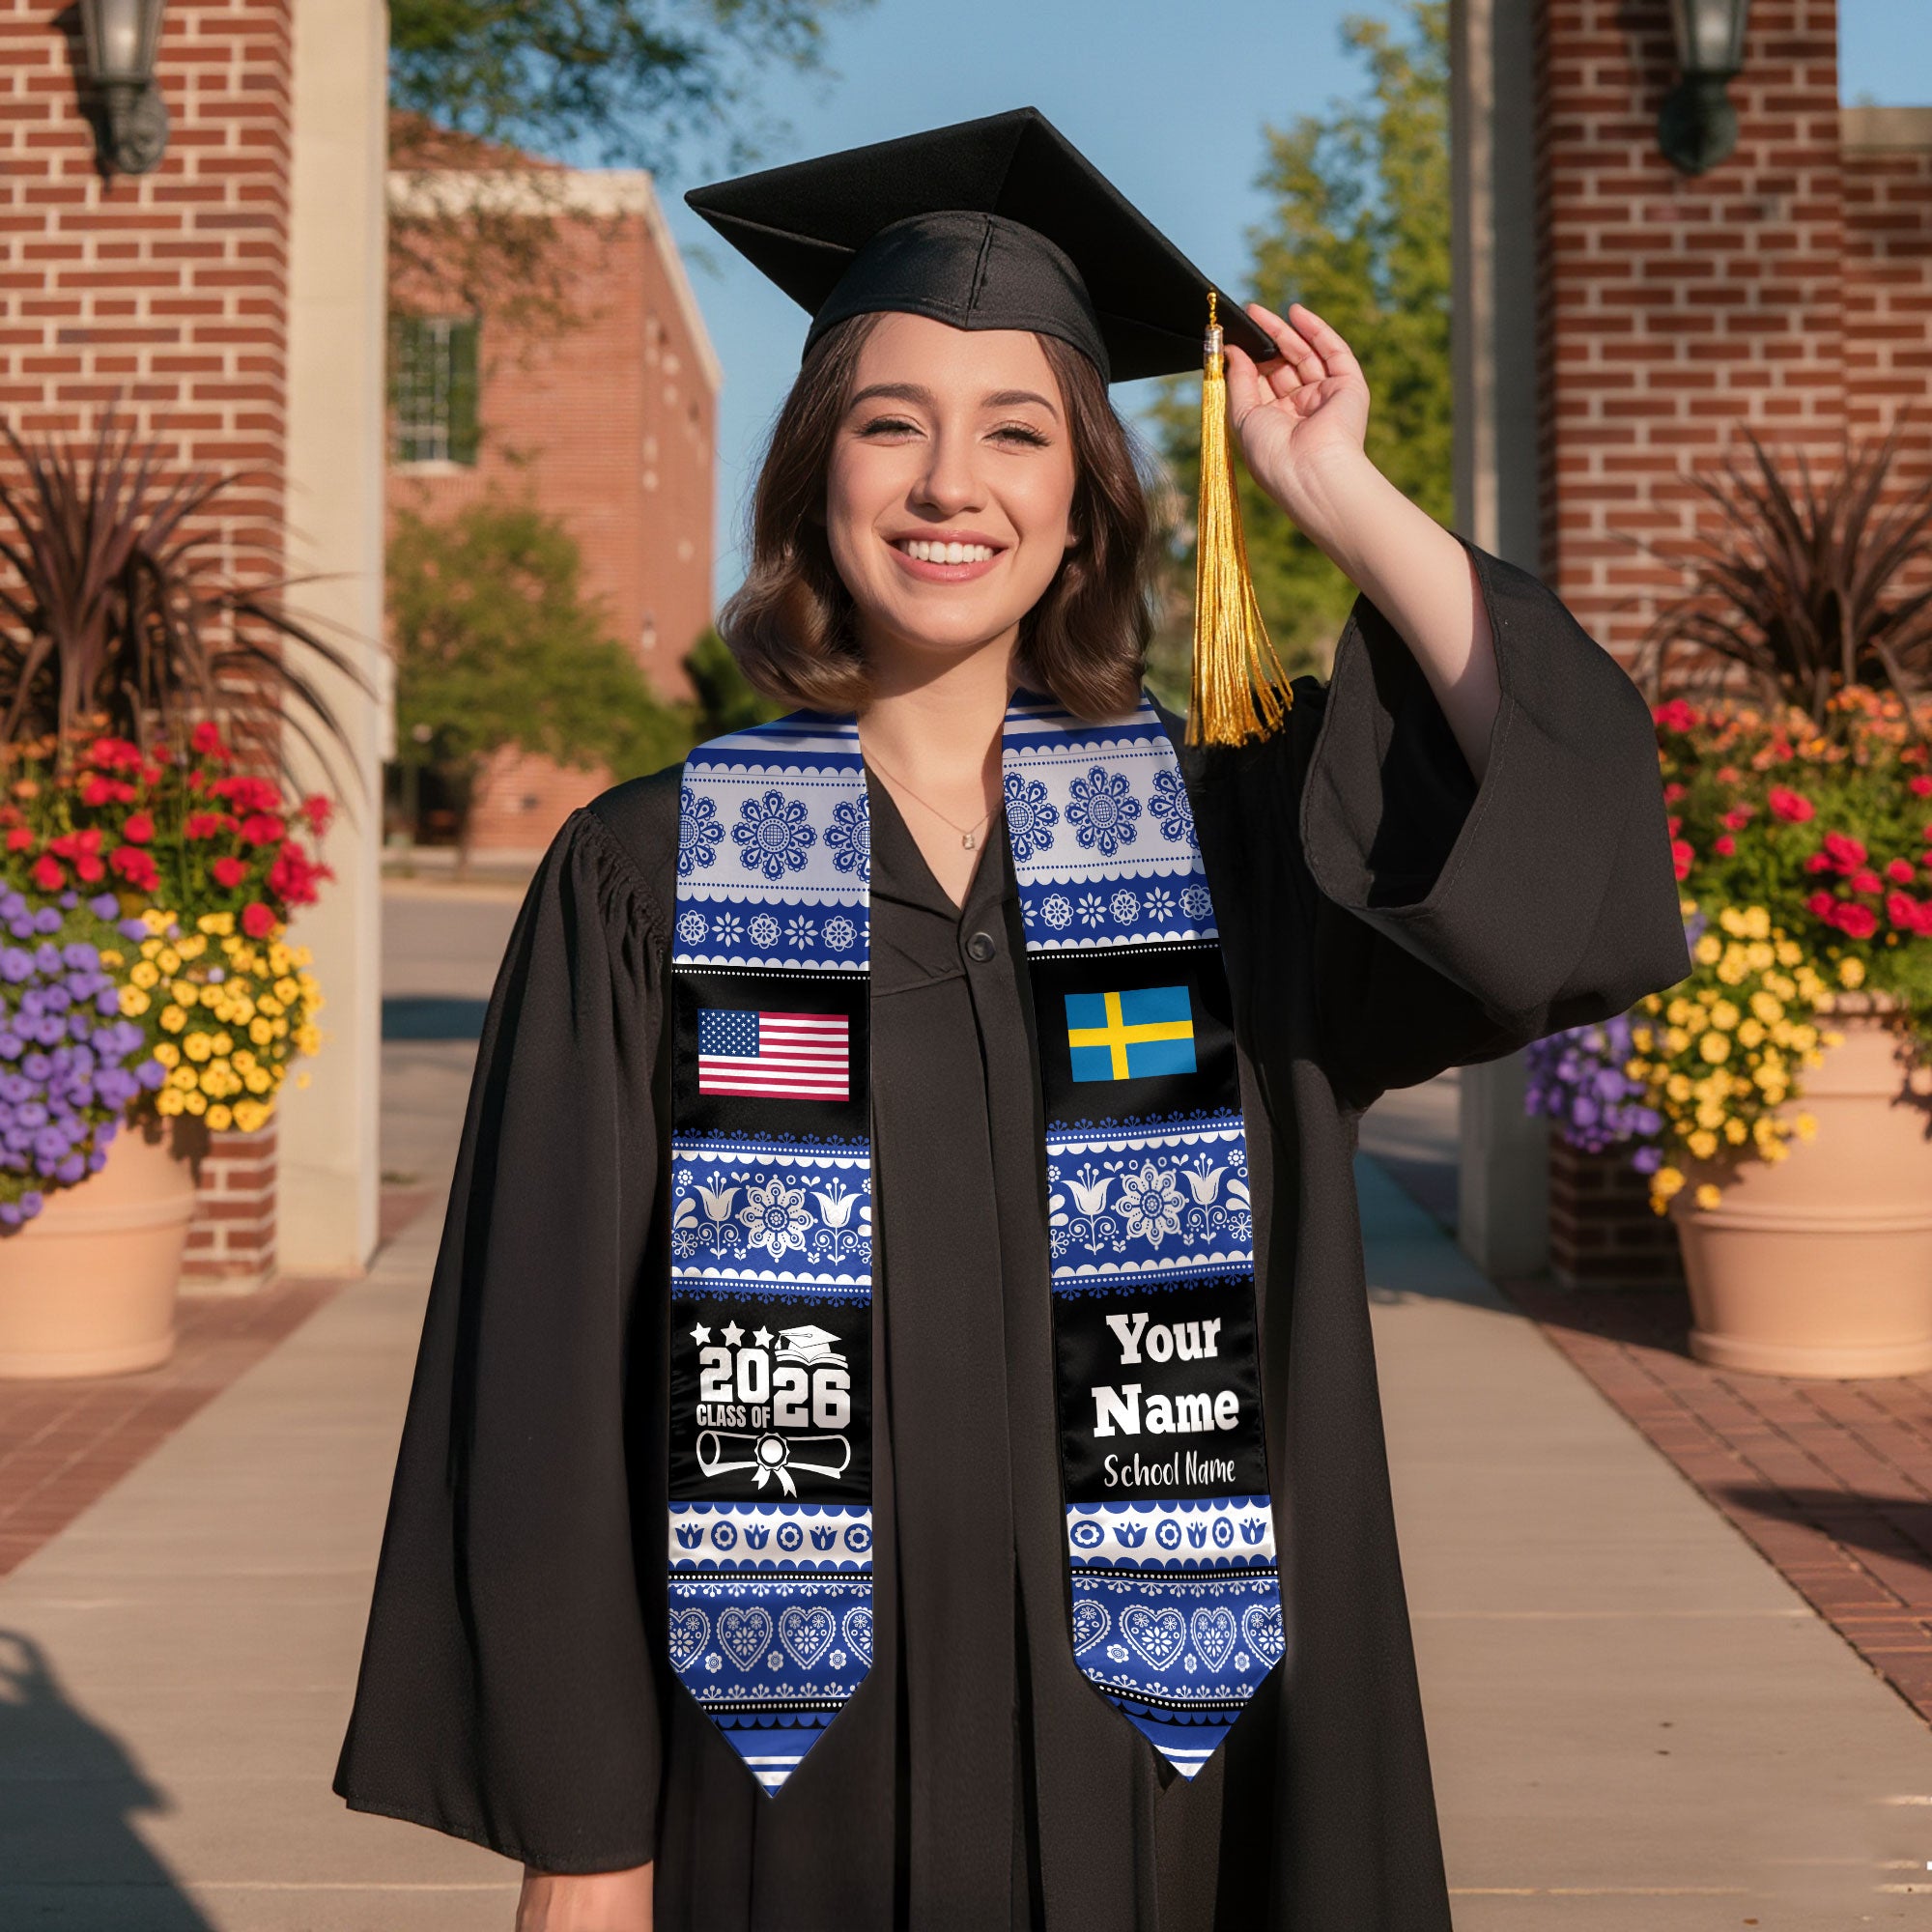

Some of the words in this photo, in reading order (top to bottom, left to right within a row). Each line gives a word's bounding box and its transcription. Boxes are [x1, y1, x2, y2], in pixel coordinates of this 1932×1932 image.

[1105, 1312, 1221, 1365] Your
[696, 1404, 747, 1428] CLASS
[751, 1406, 771, 1429] OF
[1091, 1383, 1240, 1438] Name
[1103, 1451, 1179, 1488] School
[1185, 1450, 1236, 1486] Name
